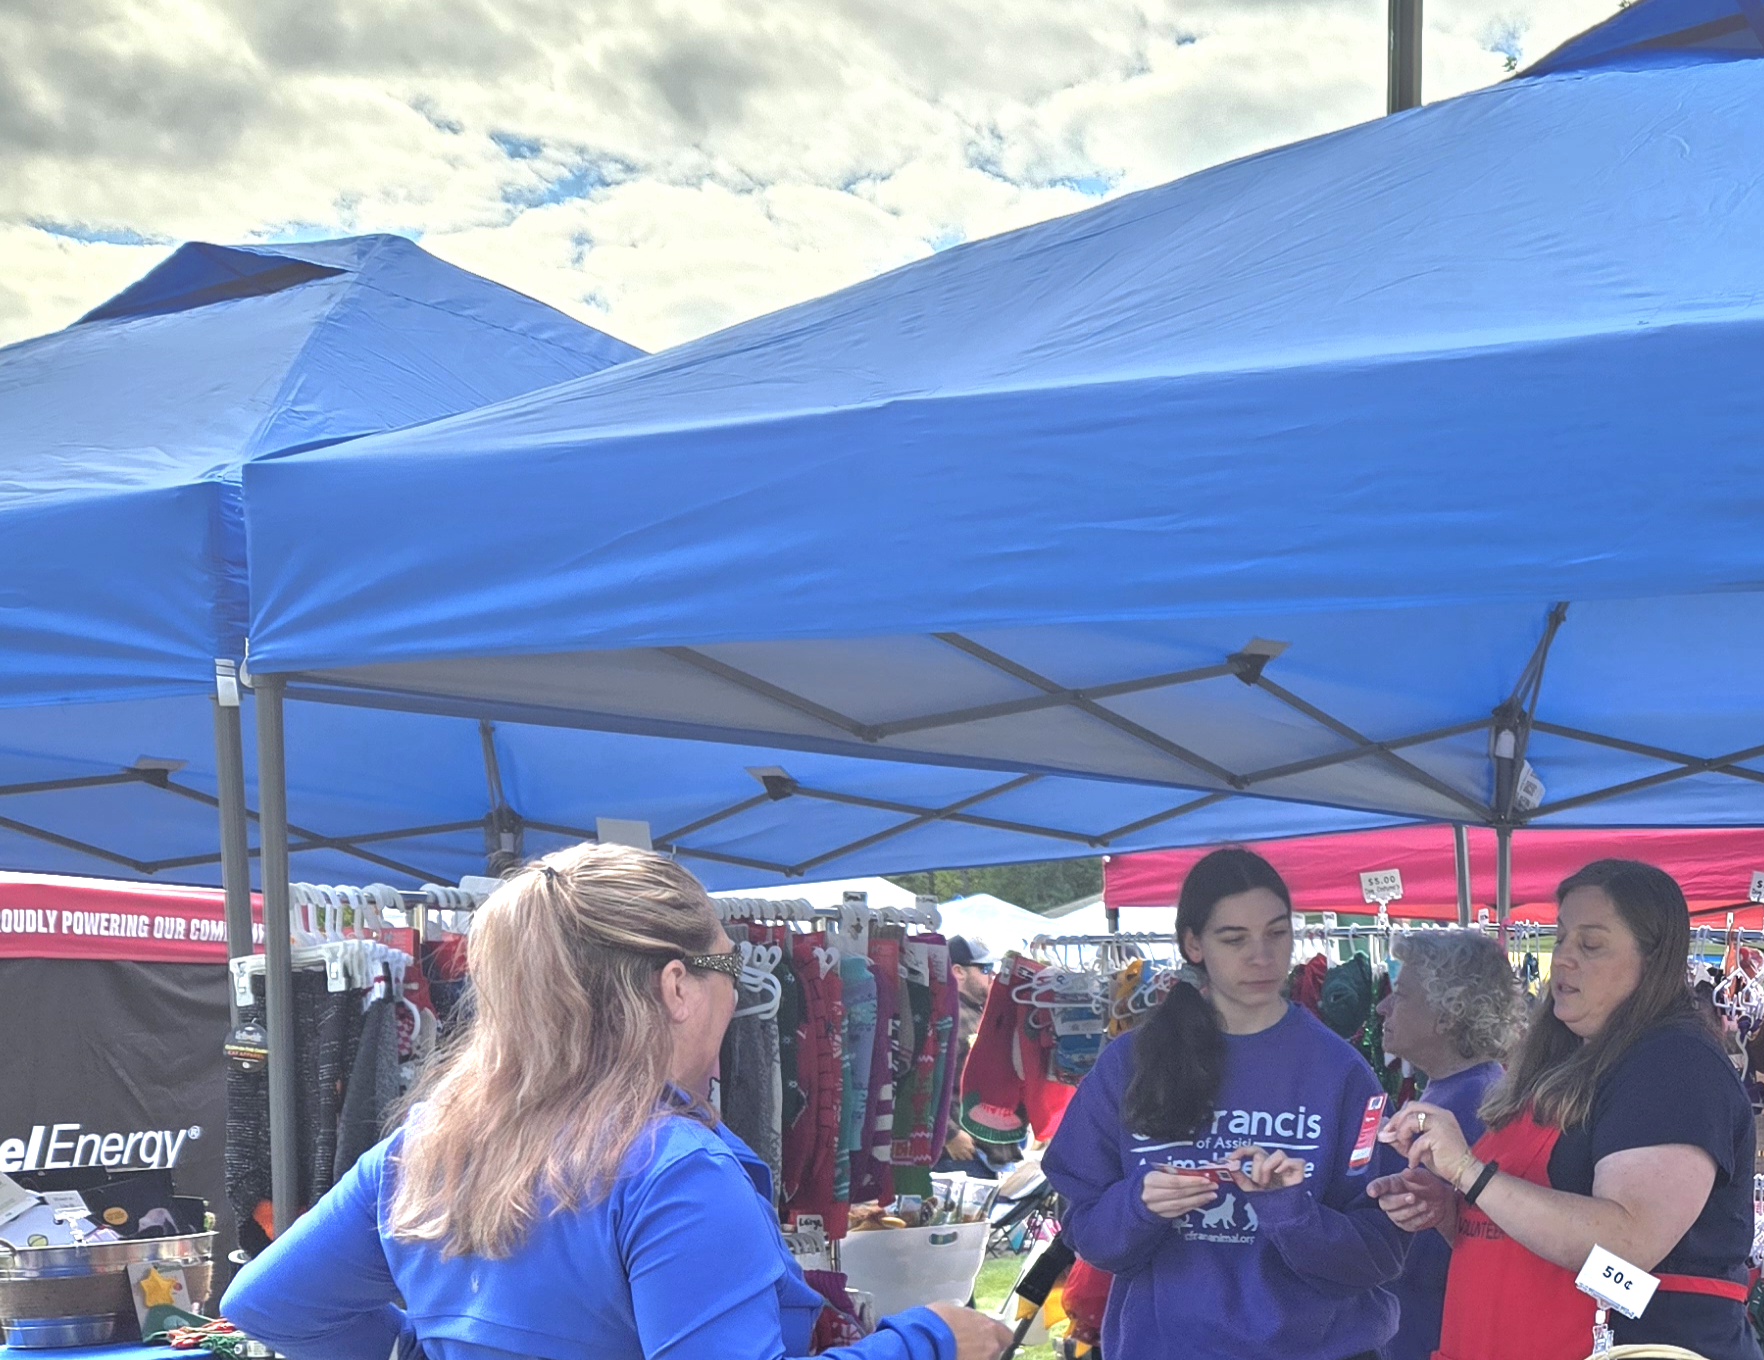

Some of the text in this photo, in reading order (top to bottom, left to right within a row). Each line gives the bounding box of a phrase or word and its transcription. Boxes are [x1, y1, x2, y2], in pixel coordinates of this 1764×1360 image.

[1368, 875, 1396, 887] $5.00
[0, 908, 58, 934] OUDLY
[61, 910, 150, 938] POWERING
[152, 915, 186, 940] OUR
[1210, 1105, 1322, 1140] rancis
[1196, 1138, 1210, 1150] of
[1602, 1265, 1634, 1291] 50¢
